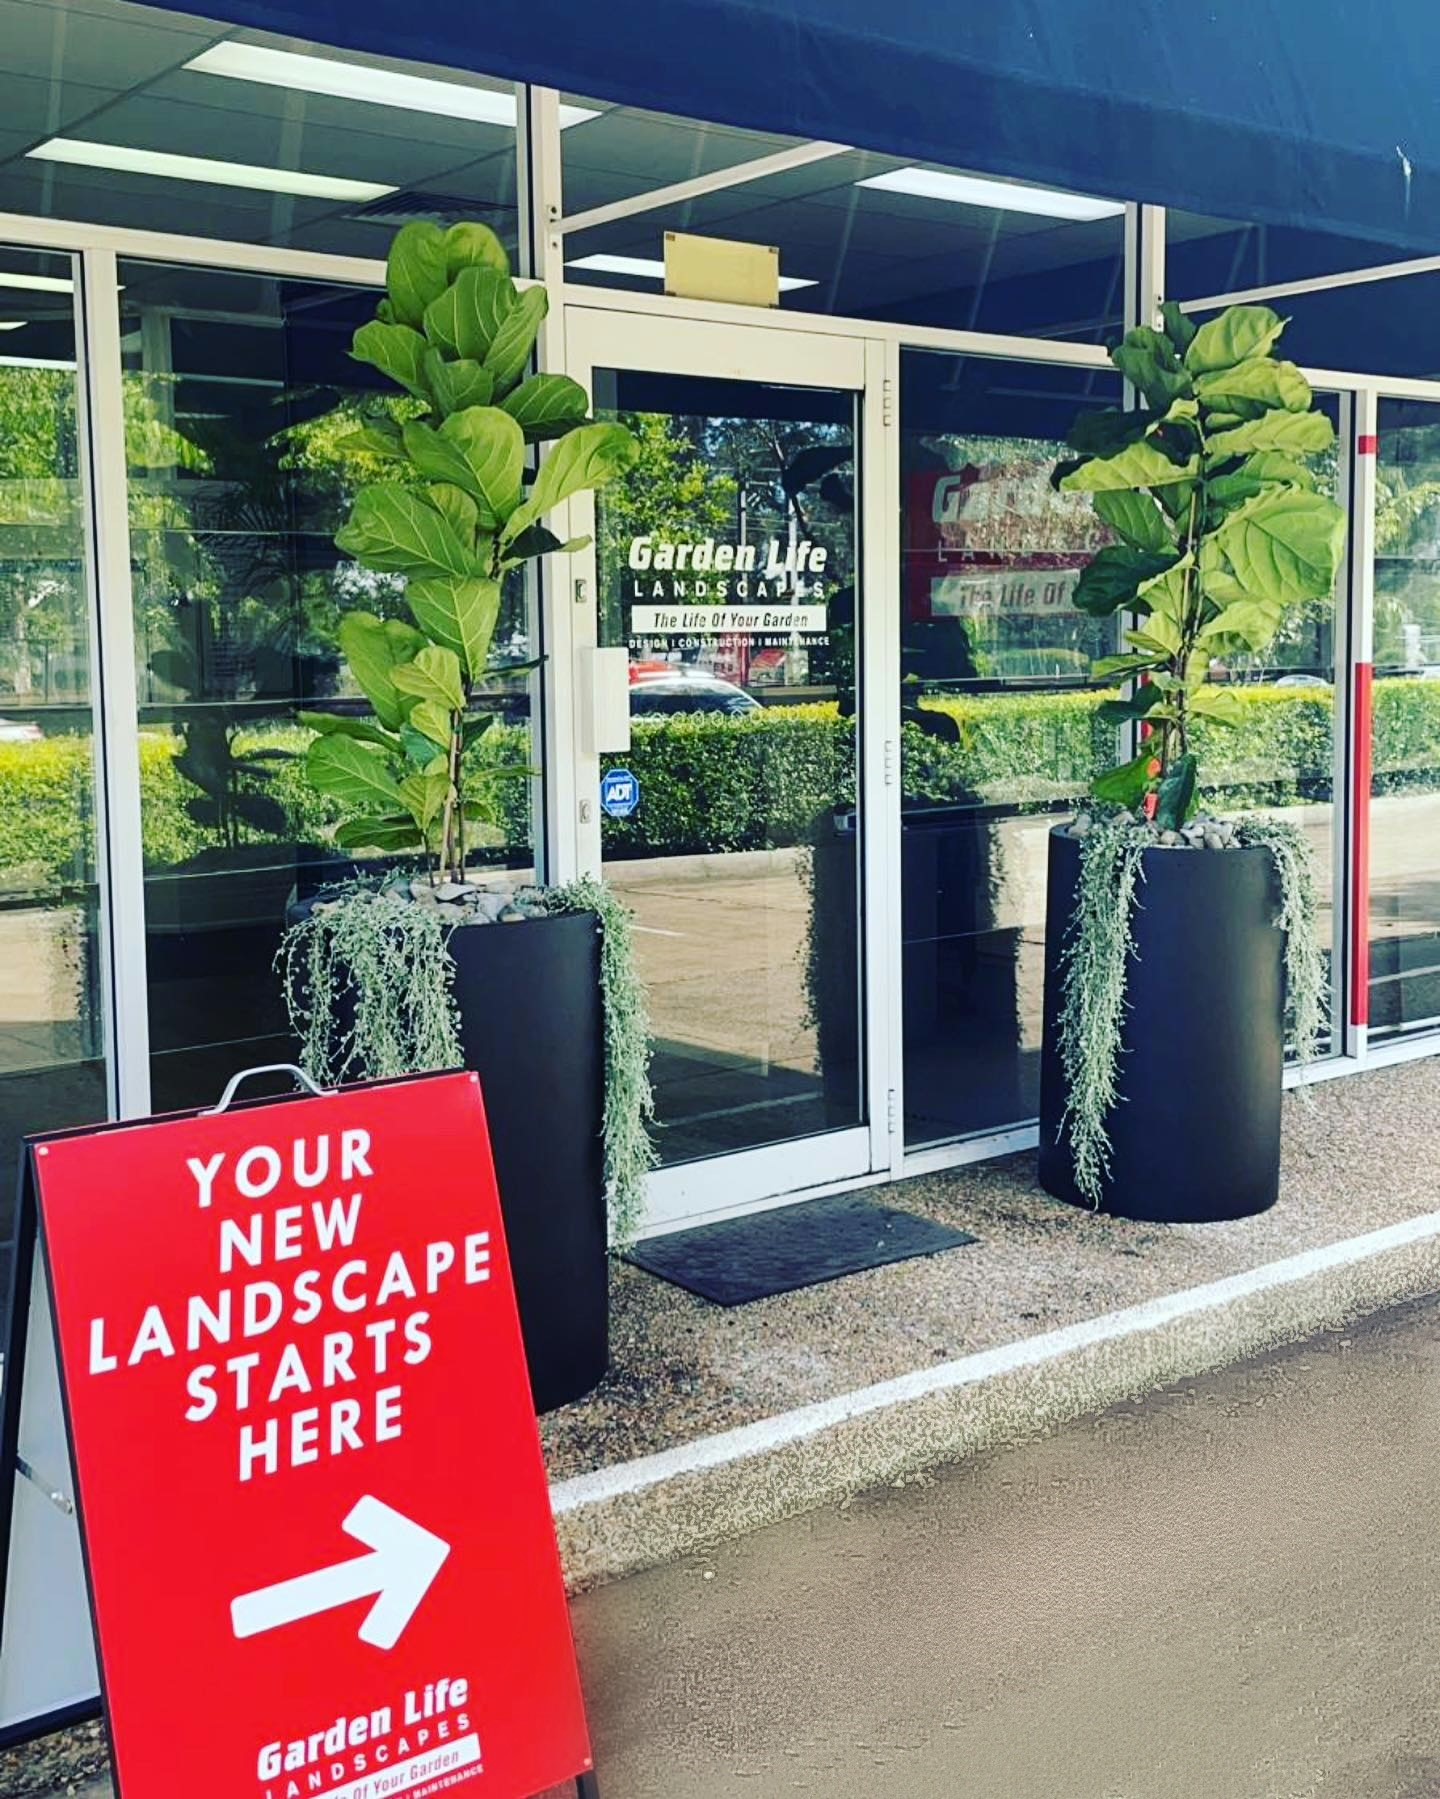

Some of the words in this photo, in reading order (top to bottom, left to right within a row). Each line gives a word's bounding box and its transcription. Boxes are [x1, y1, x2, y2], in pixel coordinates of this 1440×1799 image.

[629, 536, 756, 572] Garden
[766, 538, 828, 573] Life
[634, 579, 825, 598] LANDSCAPES
[1001, 581, 1036, 608] Life
[1044, 581, 1066, 605] Of
[654, 612, 677, 628] The
[682, 612, 706, 628] Life
[712, 612, 725, 628] Of
[730, 612, 759, 628] Your
[763, 612, 808, 628] Garden
[628, 638, 669, 650] DESIGN
[678, 637, 755, 649] CONSTRUCTION
[606, 783, 633, 801] ADT
[187, 1128, 374, 1208] YOUR
[219, 1193, 362, 1273] NEW
[89, 1231, 490, 1375] LANDSCAPE
[185, 1311, 432, 1422] STARTS
[239, 1398, 402, 1482] HERE
[257, 1706, 391, 1782] Garden
[404, 1677, 468, 1726] Life
[374, 1772, 405, 1795] Your
[410, 1751, 459, 1780] Garden
[413, 1763, 484, 1799] MAINTENANCE
